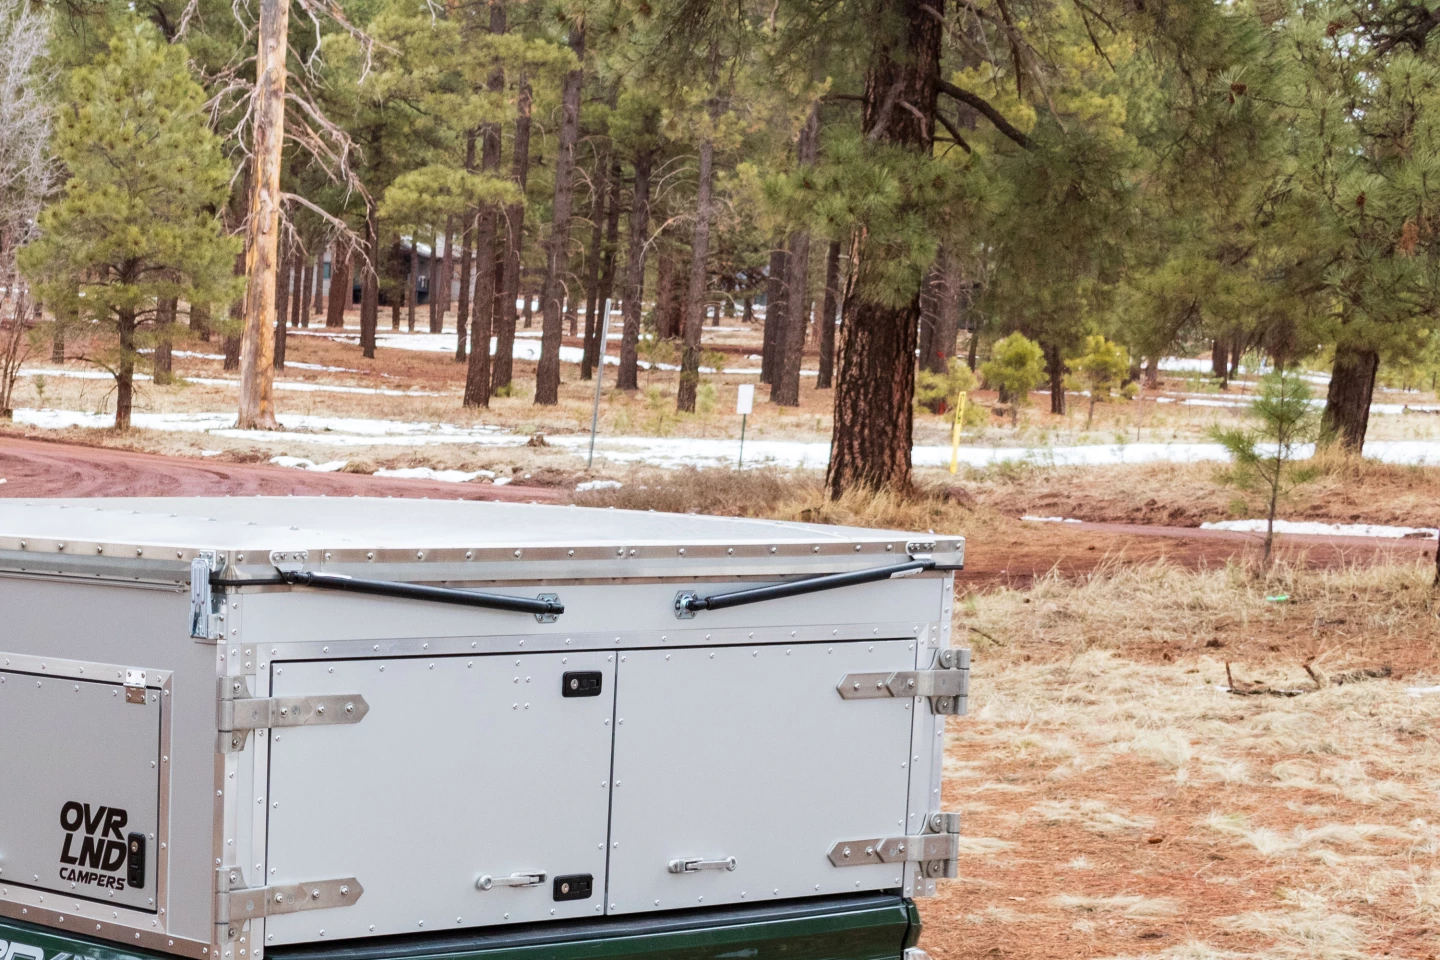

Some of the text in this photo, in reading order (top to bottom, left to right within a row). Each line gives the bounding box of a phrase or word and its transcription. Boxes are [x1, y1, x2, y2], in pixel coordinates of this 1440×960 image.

[60, 801, 127, 840] OVR
[60, 832, 127, 871] LND
[59, 867, 126, 891] CAMPERS
